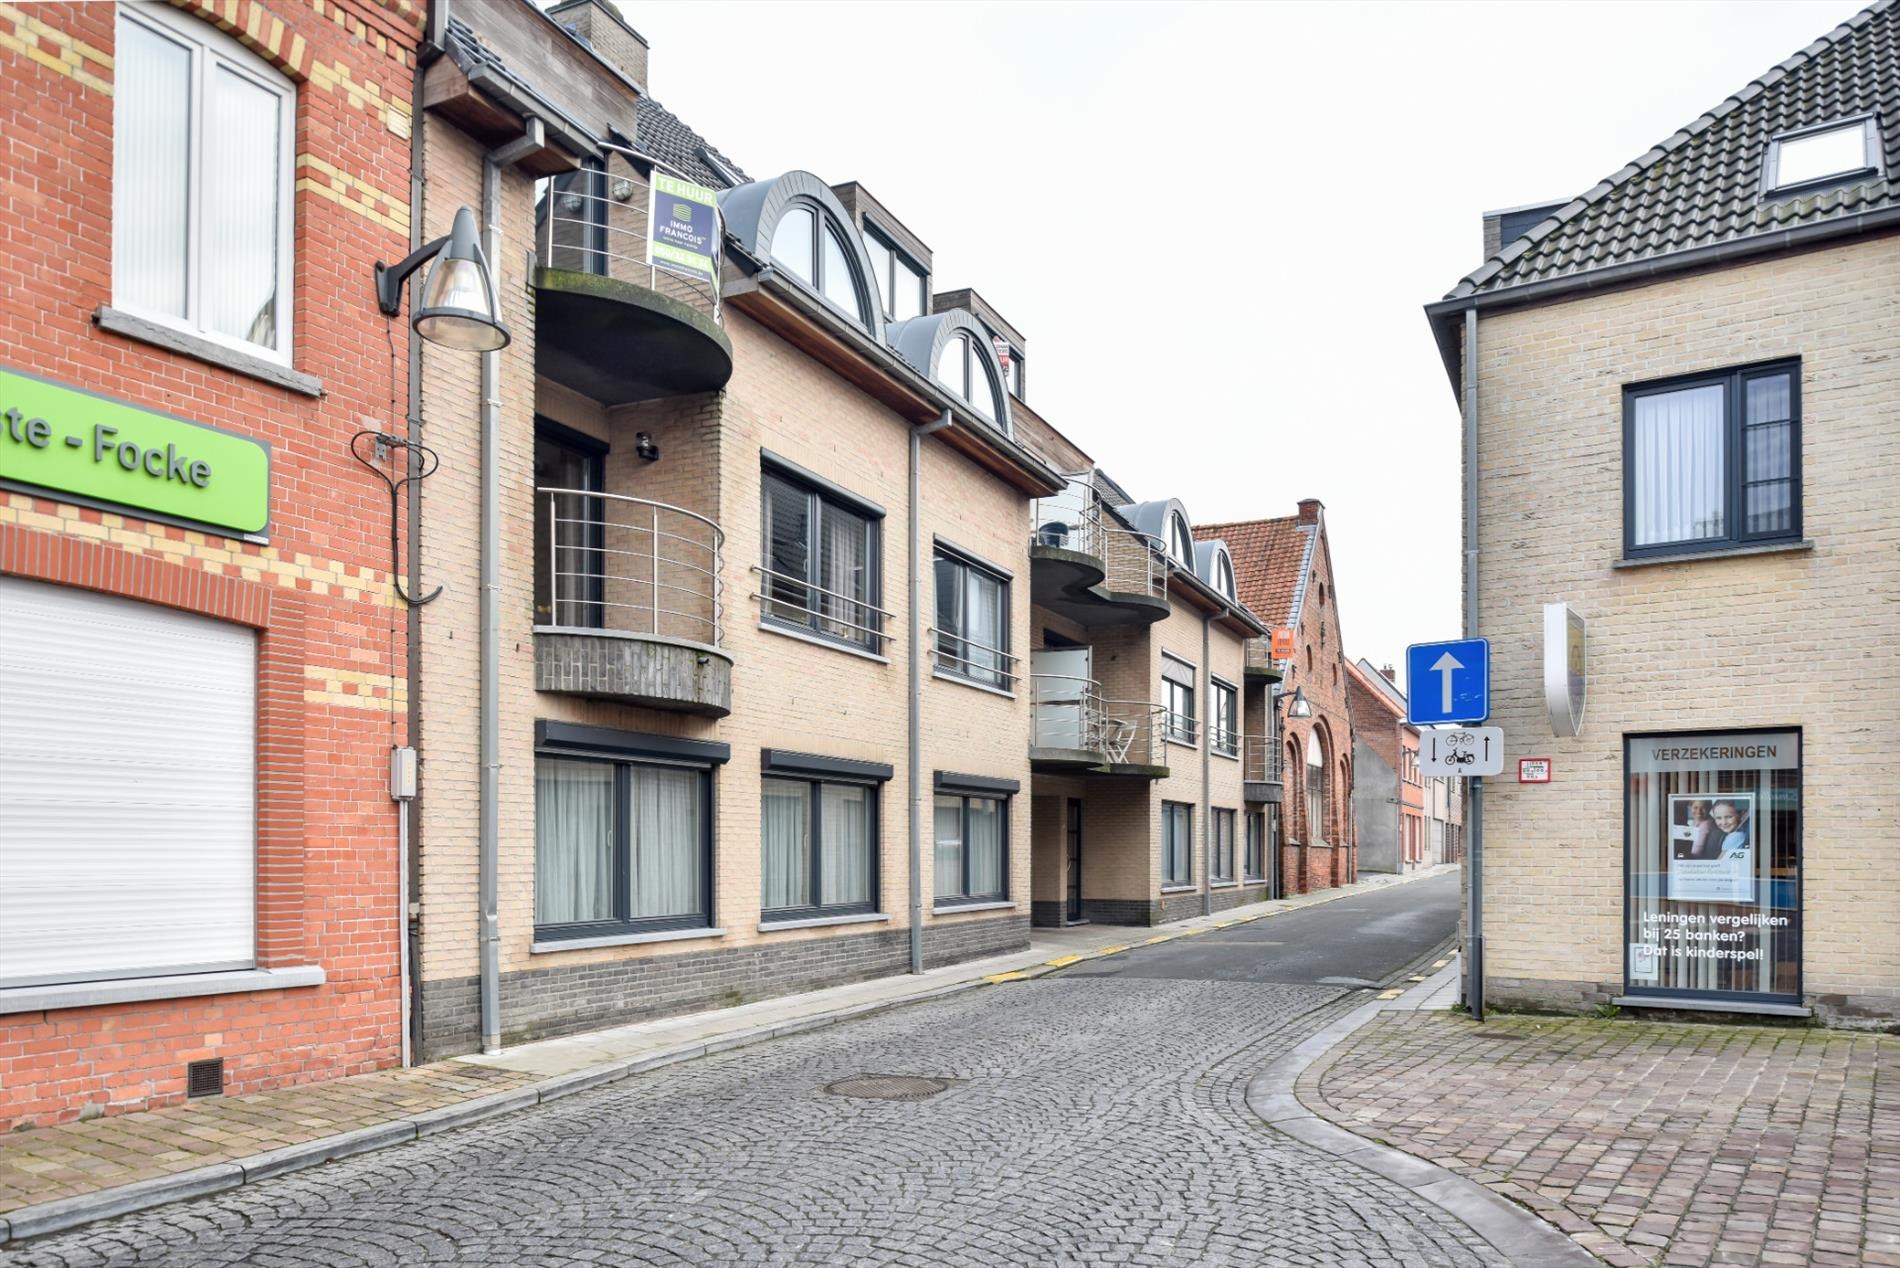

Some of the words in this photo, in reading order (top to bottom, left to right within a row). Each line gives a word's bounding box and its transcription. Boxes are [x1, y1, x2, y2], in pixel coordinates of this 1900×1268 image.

[659, 177, 674, 192] TE
[677, 181, 713, 203] HUUR
[670, 219, 693, 233] IMMO
[94, 423, 212, 489] Focke
[1652, 745, 1777, 761] VERZEKERINGEN
[1729, 851, 1745, 859] AG
[1643, 912, 1705, 926] Leningen
[1709, 913, 1788, 928] vergelijken
[1643, 928, 1660, 942] bij
[1664, 929, 1681, 940] 25
[1685, 929, 1745, 942] banken?
[1643, 945, 1668, 957] Dat
[1671, 945, 1682, 957] is
[1686, 946, 1764, 962] kinderspel!
